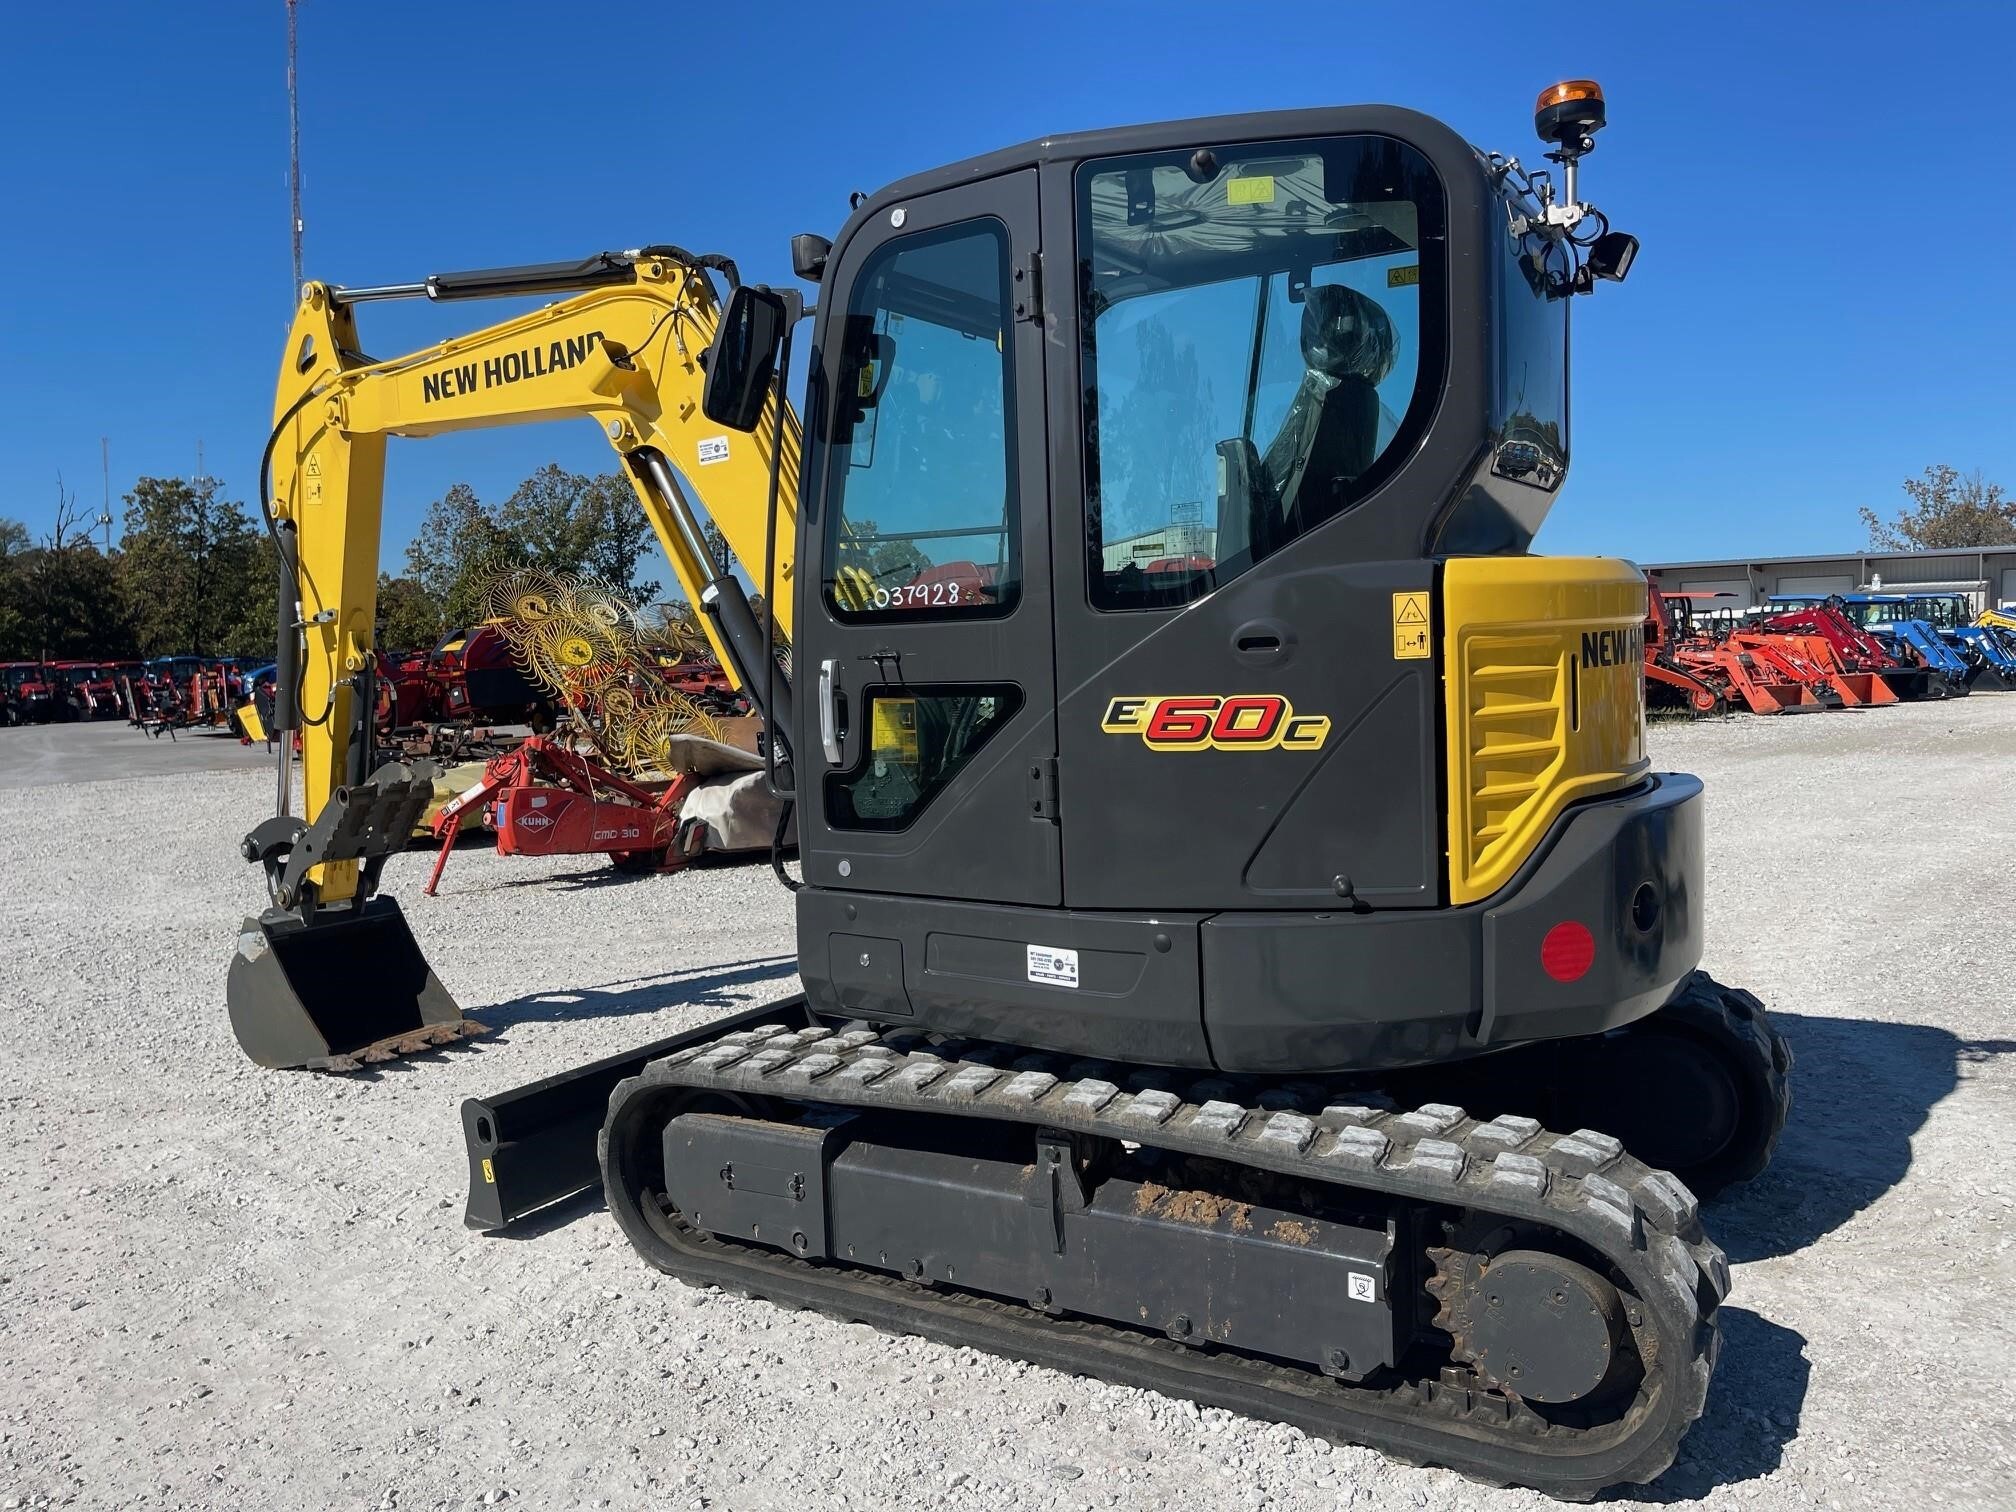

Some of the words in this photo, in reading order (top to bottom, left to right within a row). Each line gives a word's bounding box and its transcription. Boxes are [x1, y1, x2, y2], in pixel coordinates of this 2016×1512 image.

[422, 362, 478, 404] NEW
[874, 582, 959, 608] 037928
[1581, 629, 1627, 669] NEW
[521, 817, 549, 826] KUHN
[594, 829, 618, 840] GMD
[621, 828, 640, 839] 310
